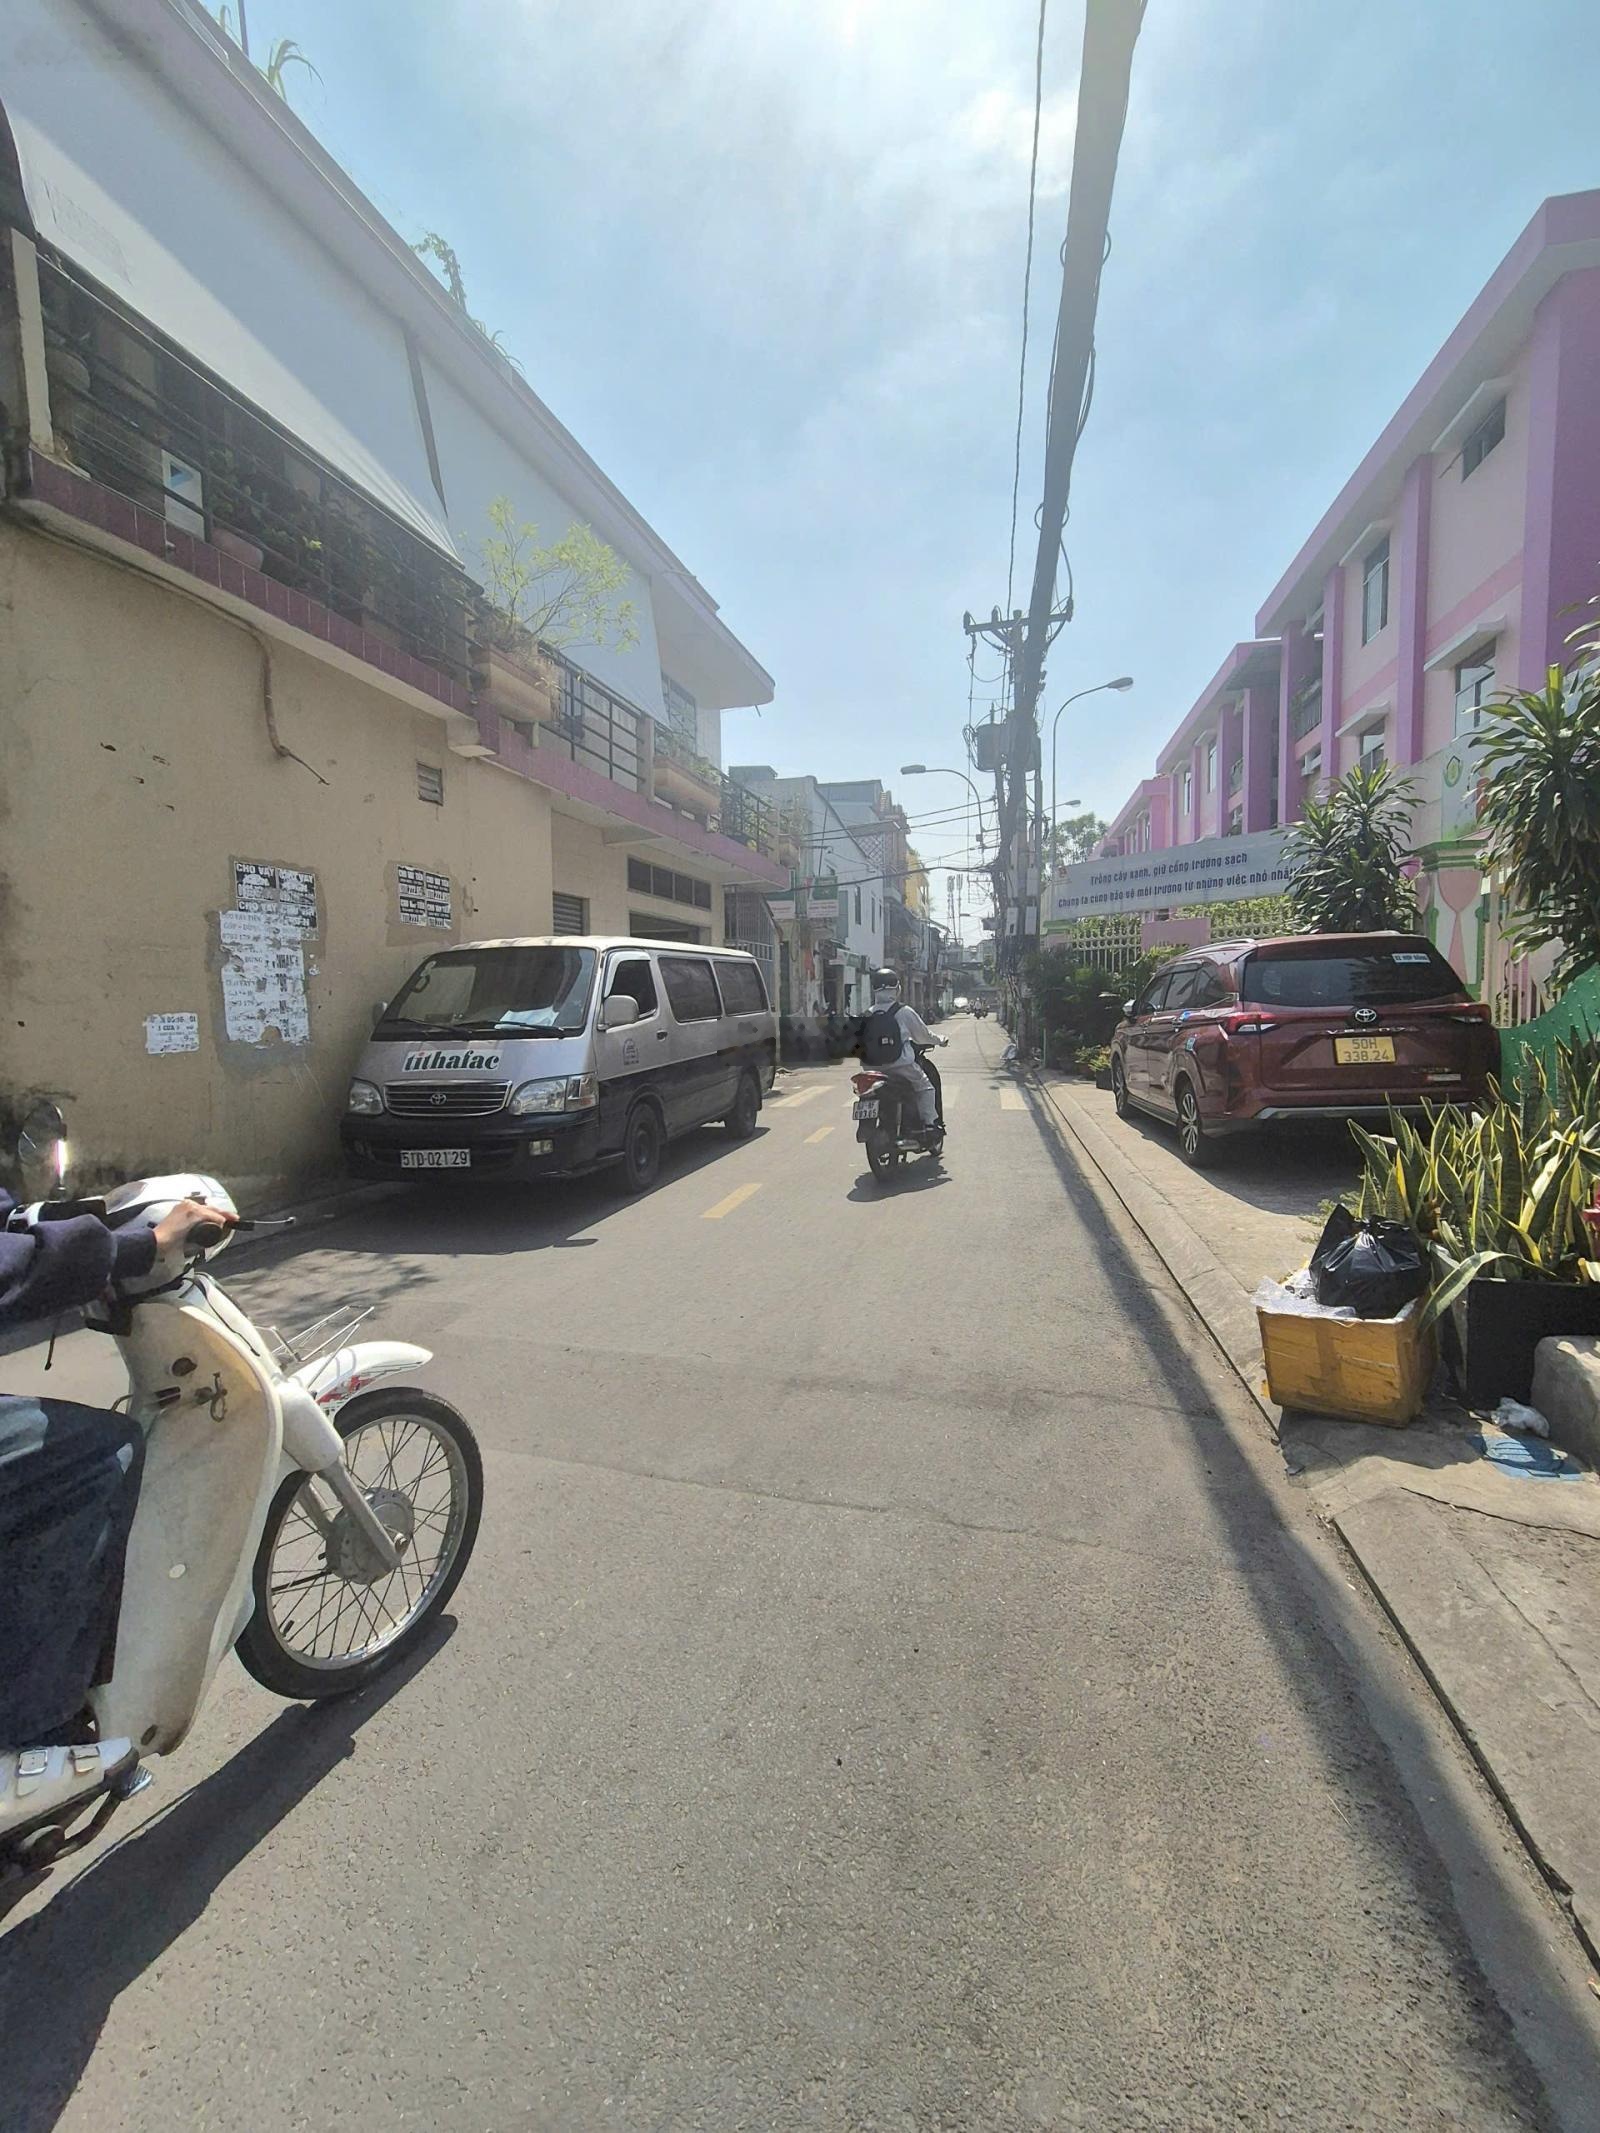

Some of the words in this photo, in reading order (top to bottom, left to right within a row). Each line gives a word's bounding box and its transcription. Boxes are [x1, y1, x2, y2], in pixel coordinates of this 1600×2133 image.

[1352, 1038, 1377, 1050] 50H
[404, 1050, 500, 1071] tithafac
[1343, 1050, 1389, 1062] 338.24
